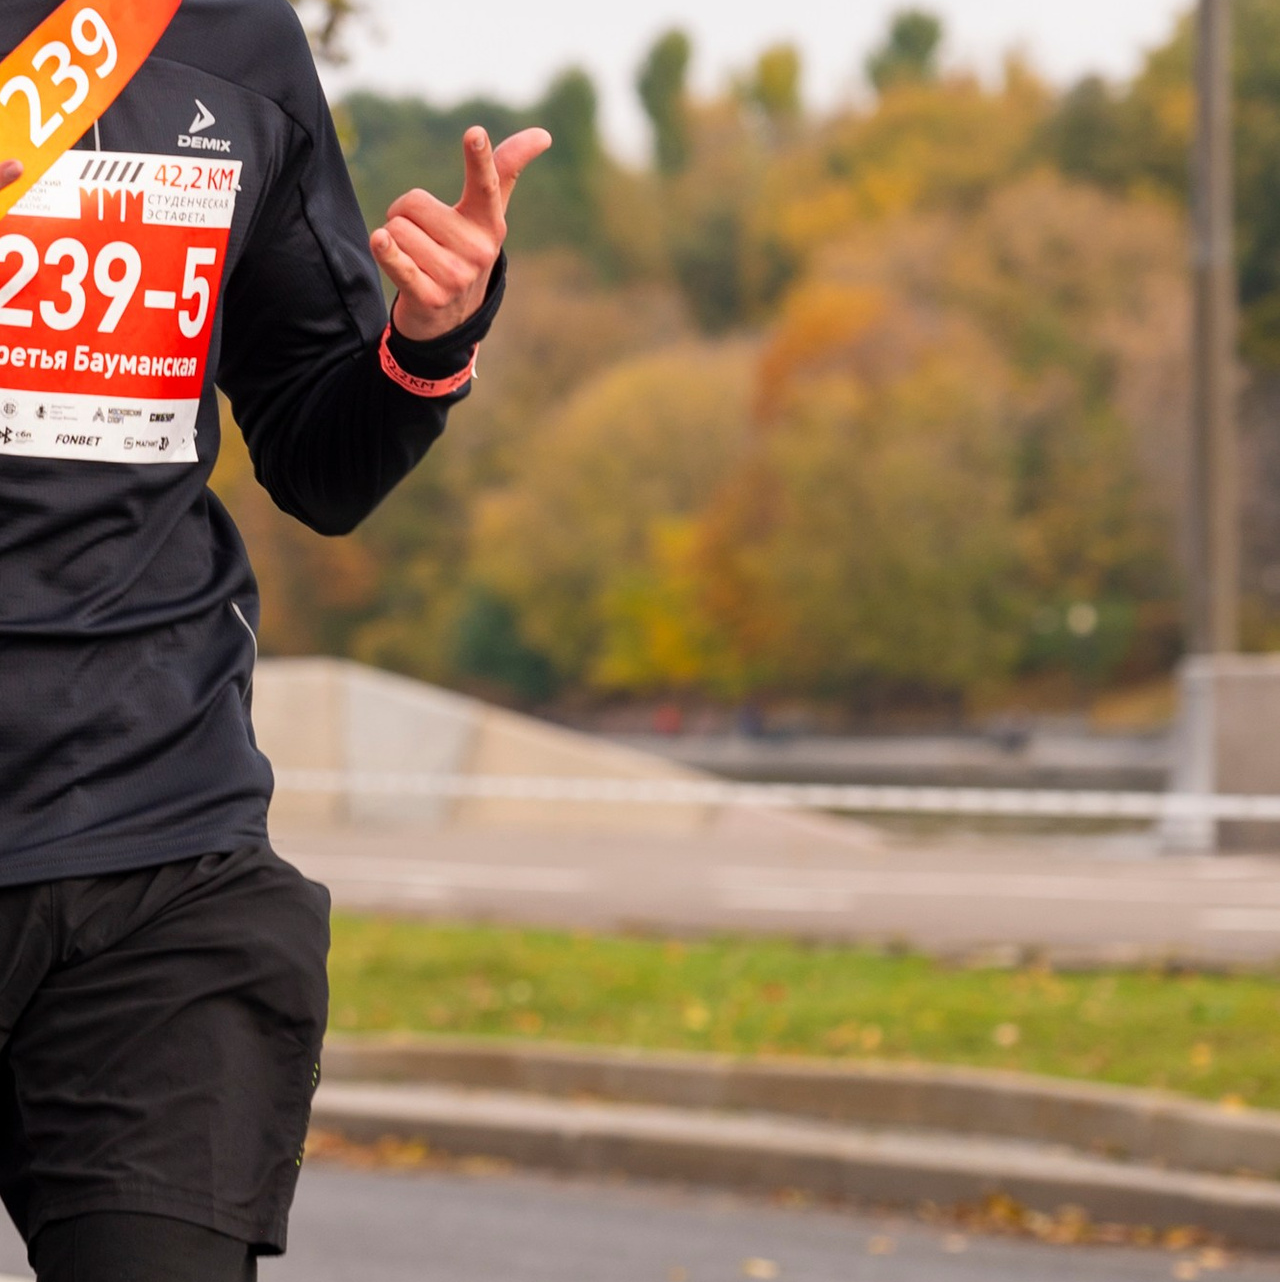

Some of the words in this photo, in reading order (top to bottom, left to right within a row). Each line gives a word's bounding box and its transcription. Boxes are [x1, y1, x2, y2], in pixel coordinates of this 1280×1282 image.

[177, 135, 231, 152] DEMIX
[154, 164, 203, 191] 42,2
[148, 194, 229, 209] СТУДЕНЧЕСКАЯ
[147, 209, 206, 223] ЭСТАФЕТА
[74, 345, 197, 379] Бауманская
[55, 434, 102, 447] FONBET
